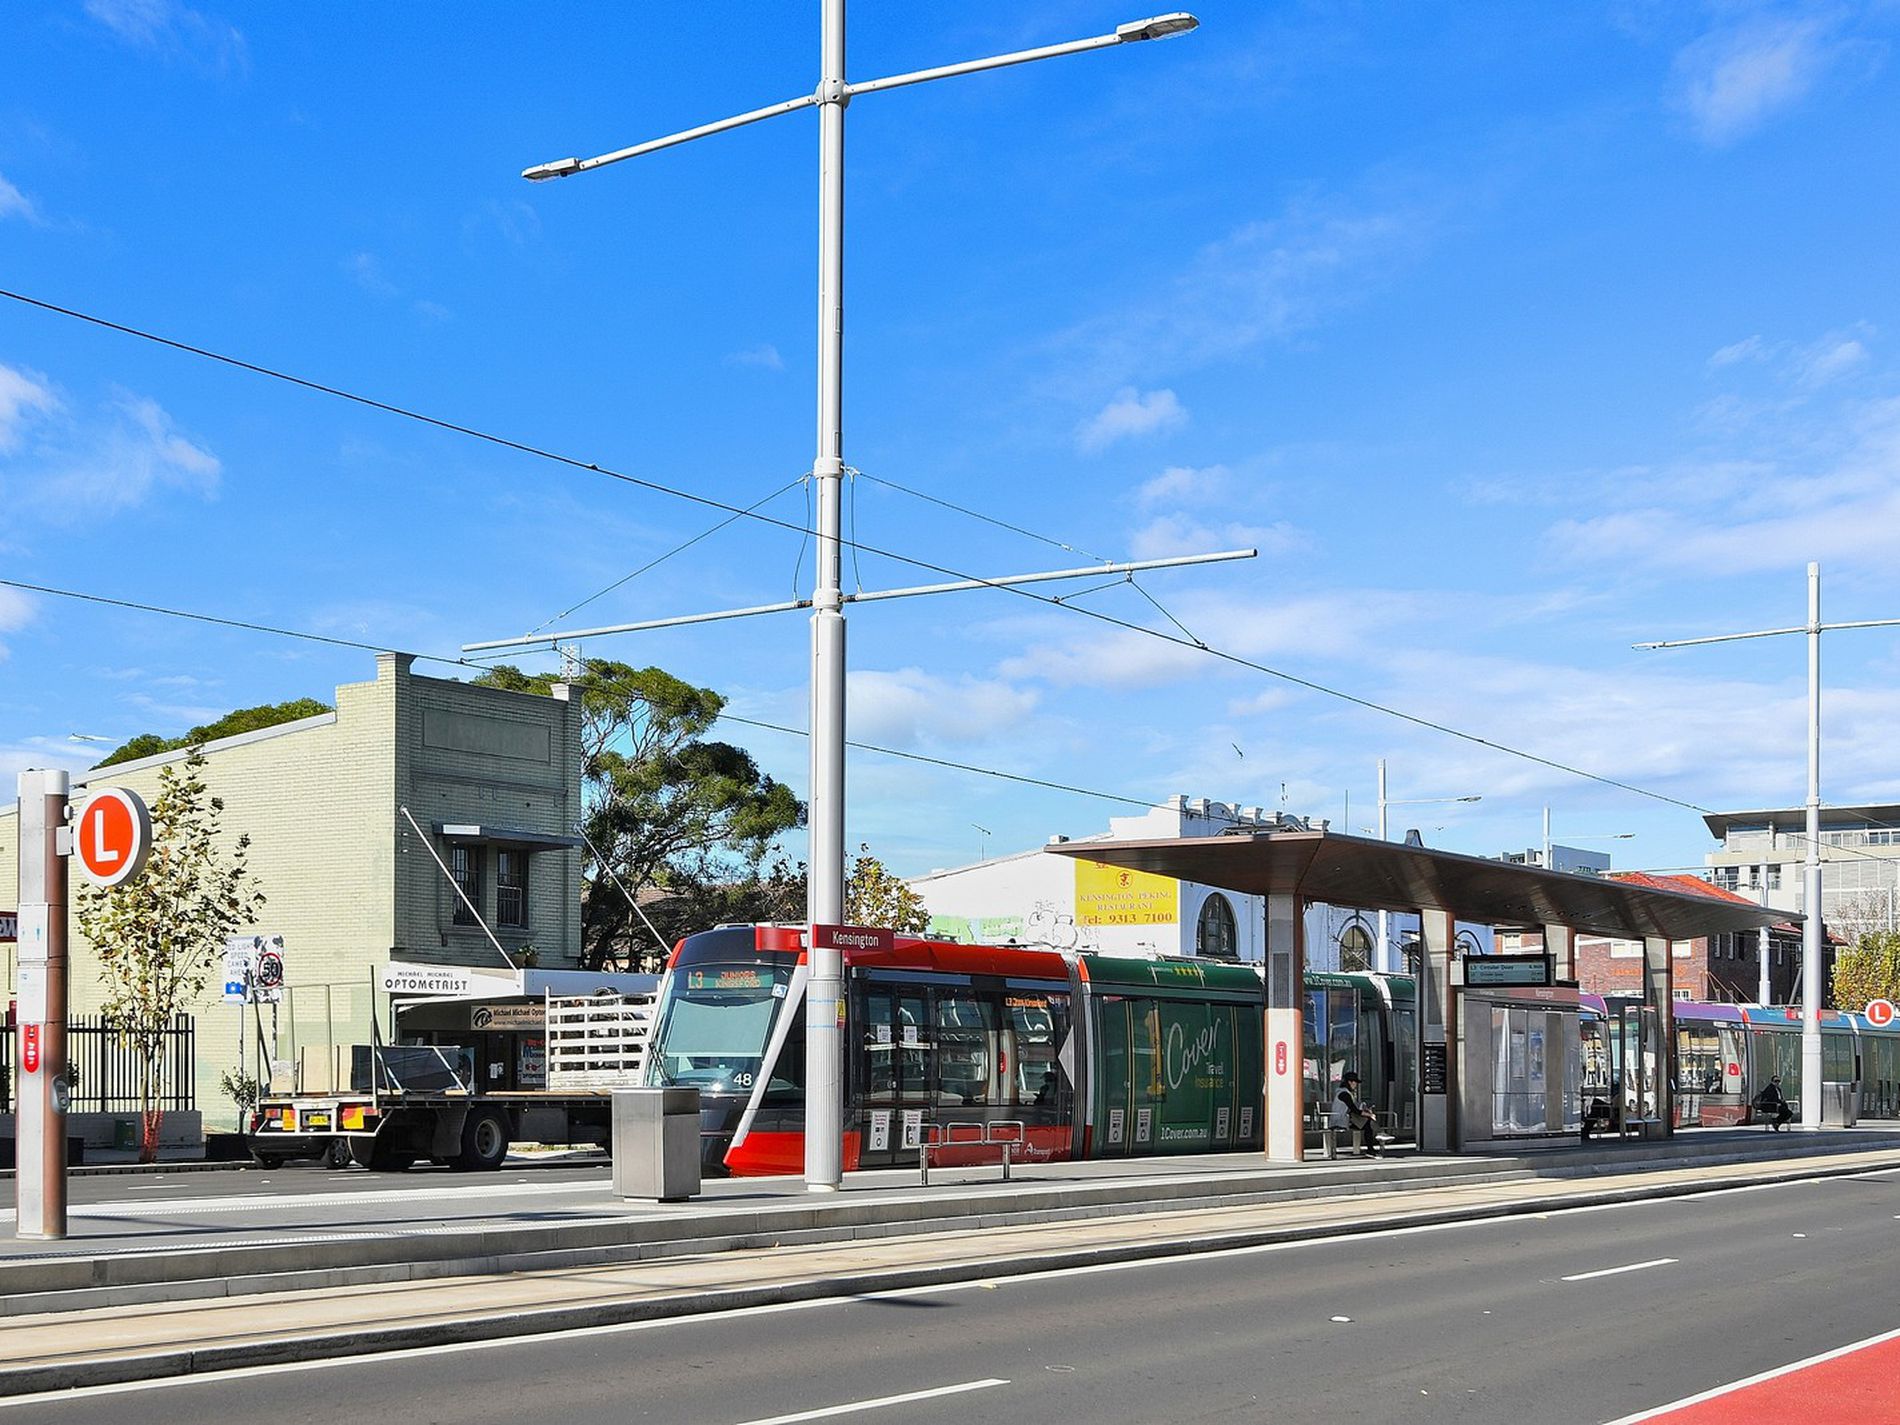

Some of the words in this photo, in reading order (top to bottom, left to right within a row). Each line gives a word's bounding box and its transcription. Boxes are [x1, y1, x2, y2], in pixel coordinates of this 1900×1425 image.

[94, 809, 119, 863] L
[1080, 893, 1133, 902] KENSINGTON
[1084, 914, 1102, 925] Tel:
[1109, 914, 1137, 923] 9313
[1144, 913, 1173, 922] 7100
[832, 930, 879, 950] Kensington
[262, 961, 279, 978] 50
[384, 978, 468, 991] OPTOMETRIST
[687, 971, 704, 989] L3
[1874, 1005, 1886, 1021] L
[1167, 1017, 1222, 1090] Cover
[733, 1072, 752, 1086] 48
[1161, 1127, 1209, 1140] 1Cover.com.au
